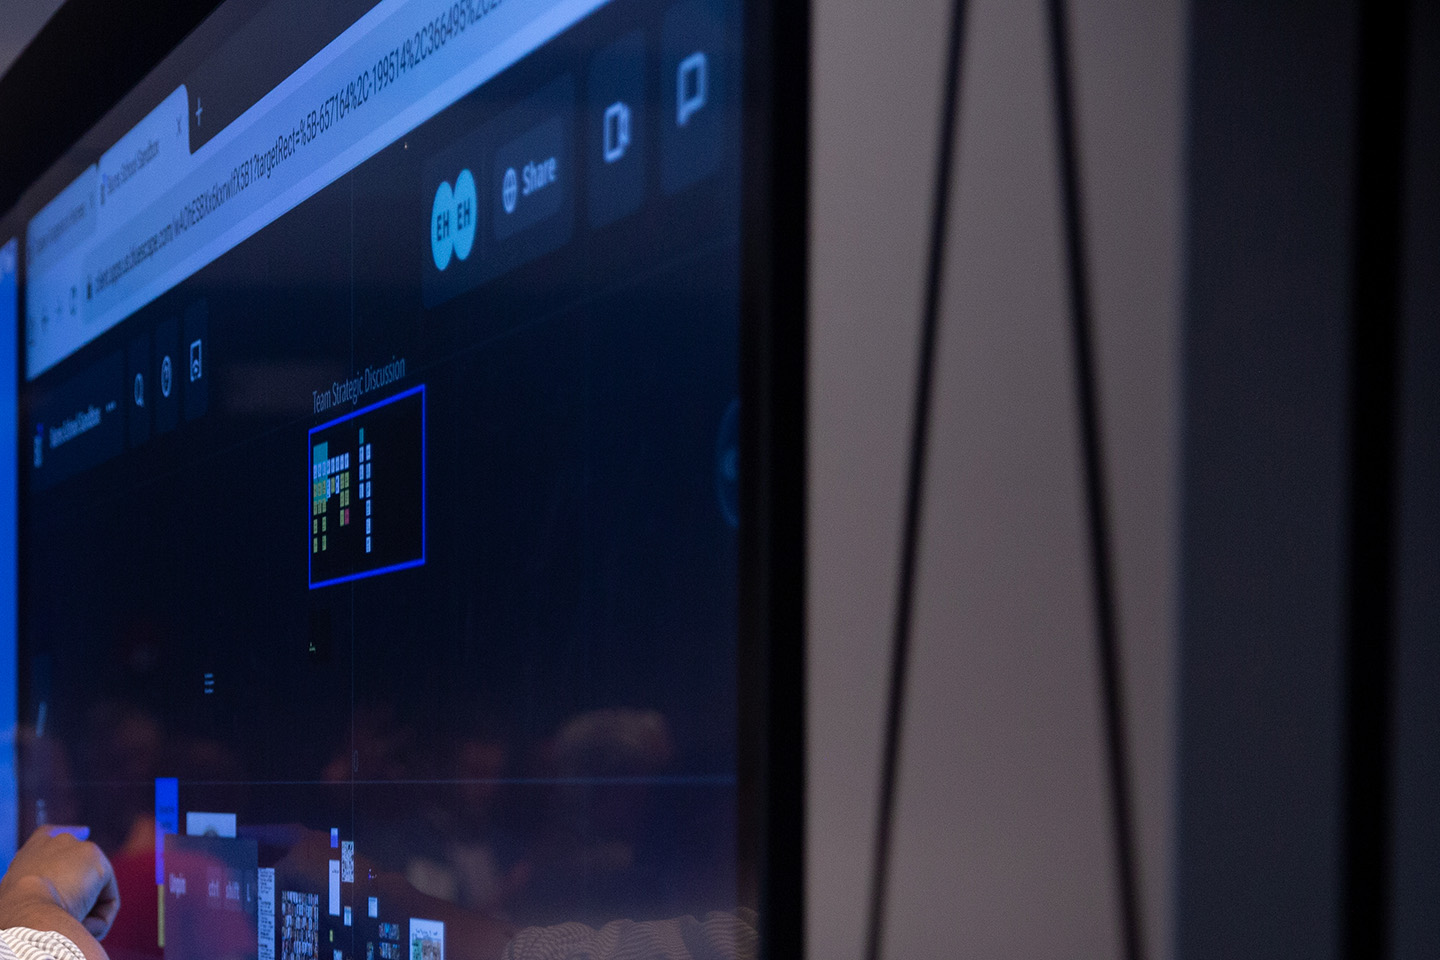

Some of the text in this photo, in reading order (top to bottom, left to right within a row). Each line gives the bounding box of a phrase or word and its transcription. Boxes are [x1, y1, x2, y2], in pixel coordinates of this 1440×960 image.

[522, 157, 556, 195] Share
[435, 198, 470, 241] EH EH
[312, 355, 405, 413] Team Strategic Discussion
